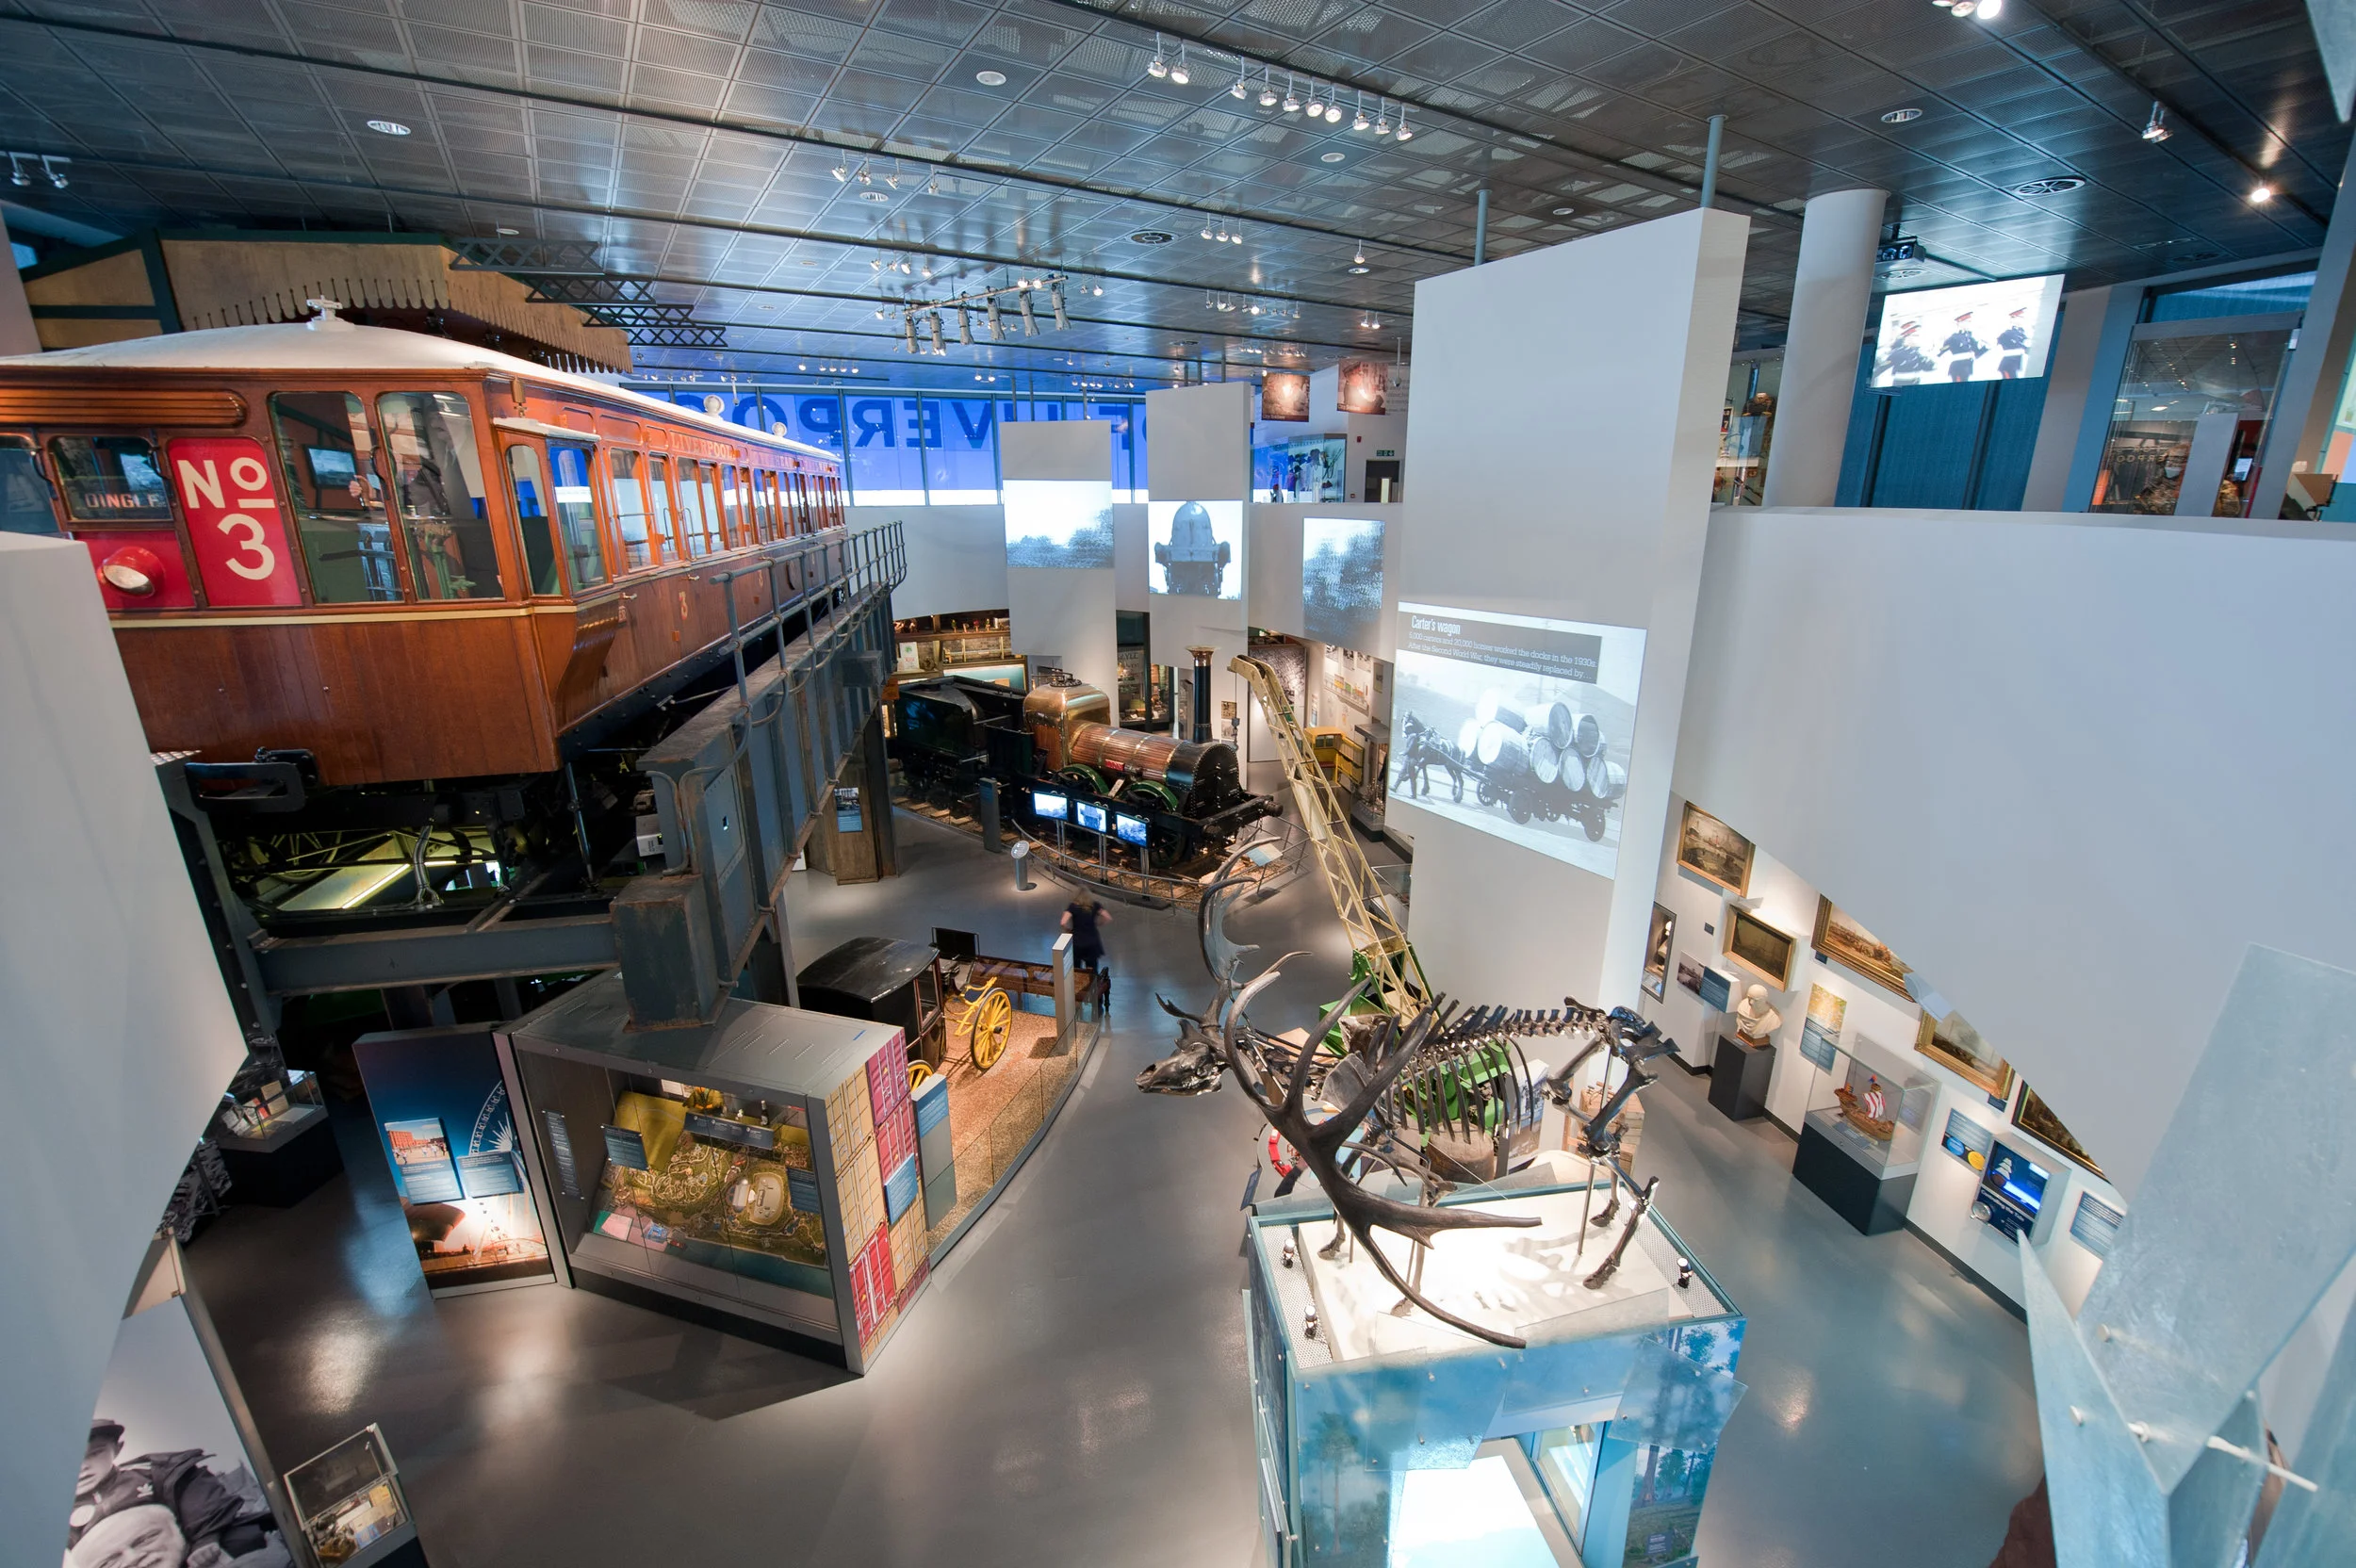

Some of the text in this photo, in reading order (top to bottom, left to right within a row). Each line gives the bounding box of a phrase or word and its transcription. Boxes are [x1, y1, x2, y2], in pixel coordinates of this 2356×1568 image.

[217, 513, 275, 580] 3
[1437, 621, 1461, 636] wagon
[1432, 645, 1451, 655] Second
[1452, 647, 1469, 659] World
[1483, 654, 1498, 665] they
[1498, 658, 1515, 666] were
[1515, 660, 1542, 672] steadily
[1543, 664, 1573, 677] replaced
[1494, 645, 1517, 655] worked
[1518, 647, 1530, 658] the
[1530, 650, 1551, 660] docks
[1561, 655, 1573, 663] the
